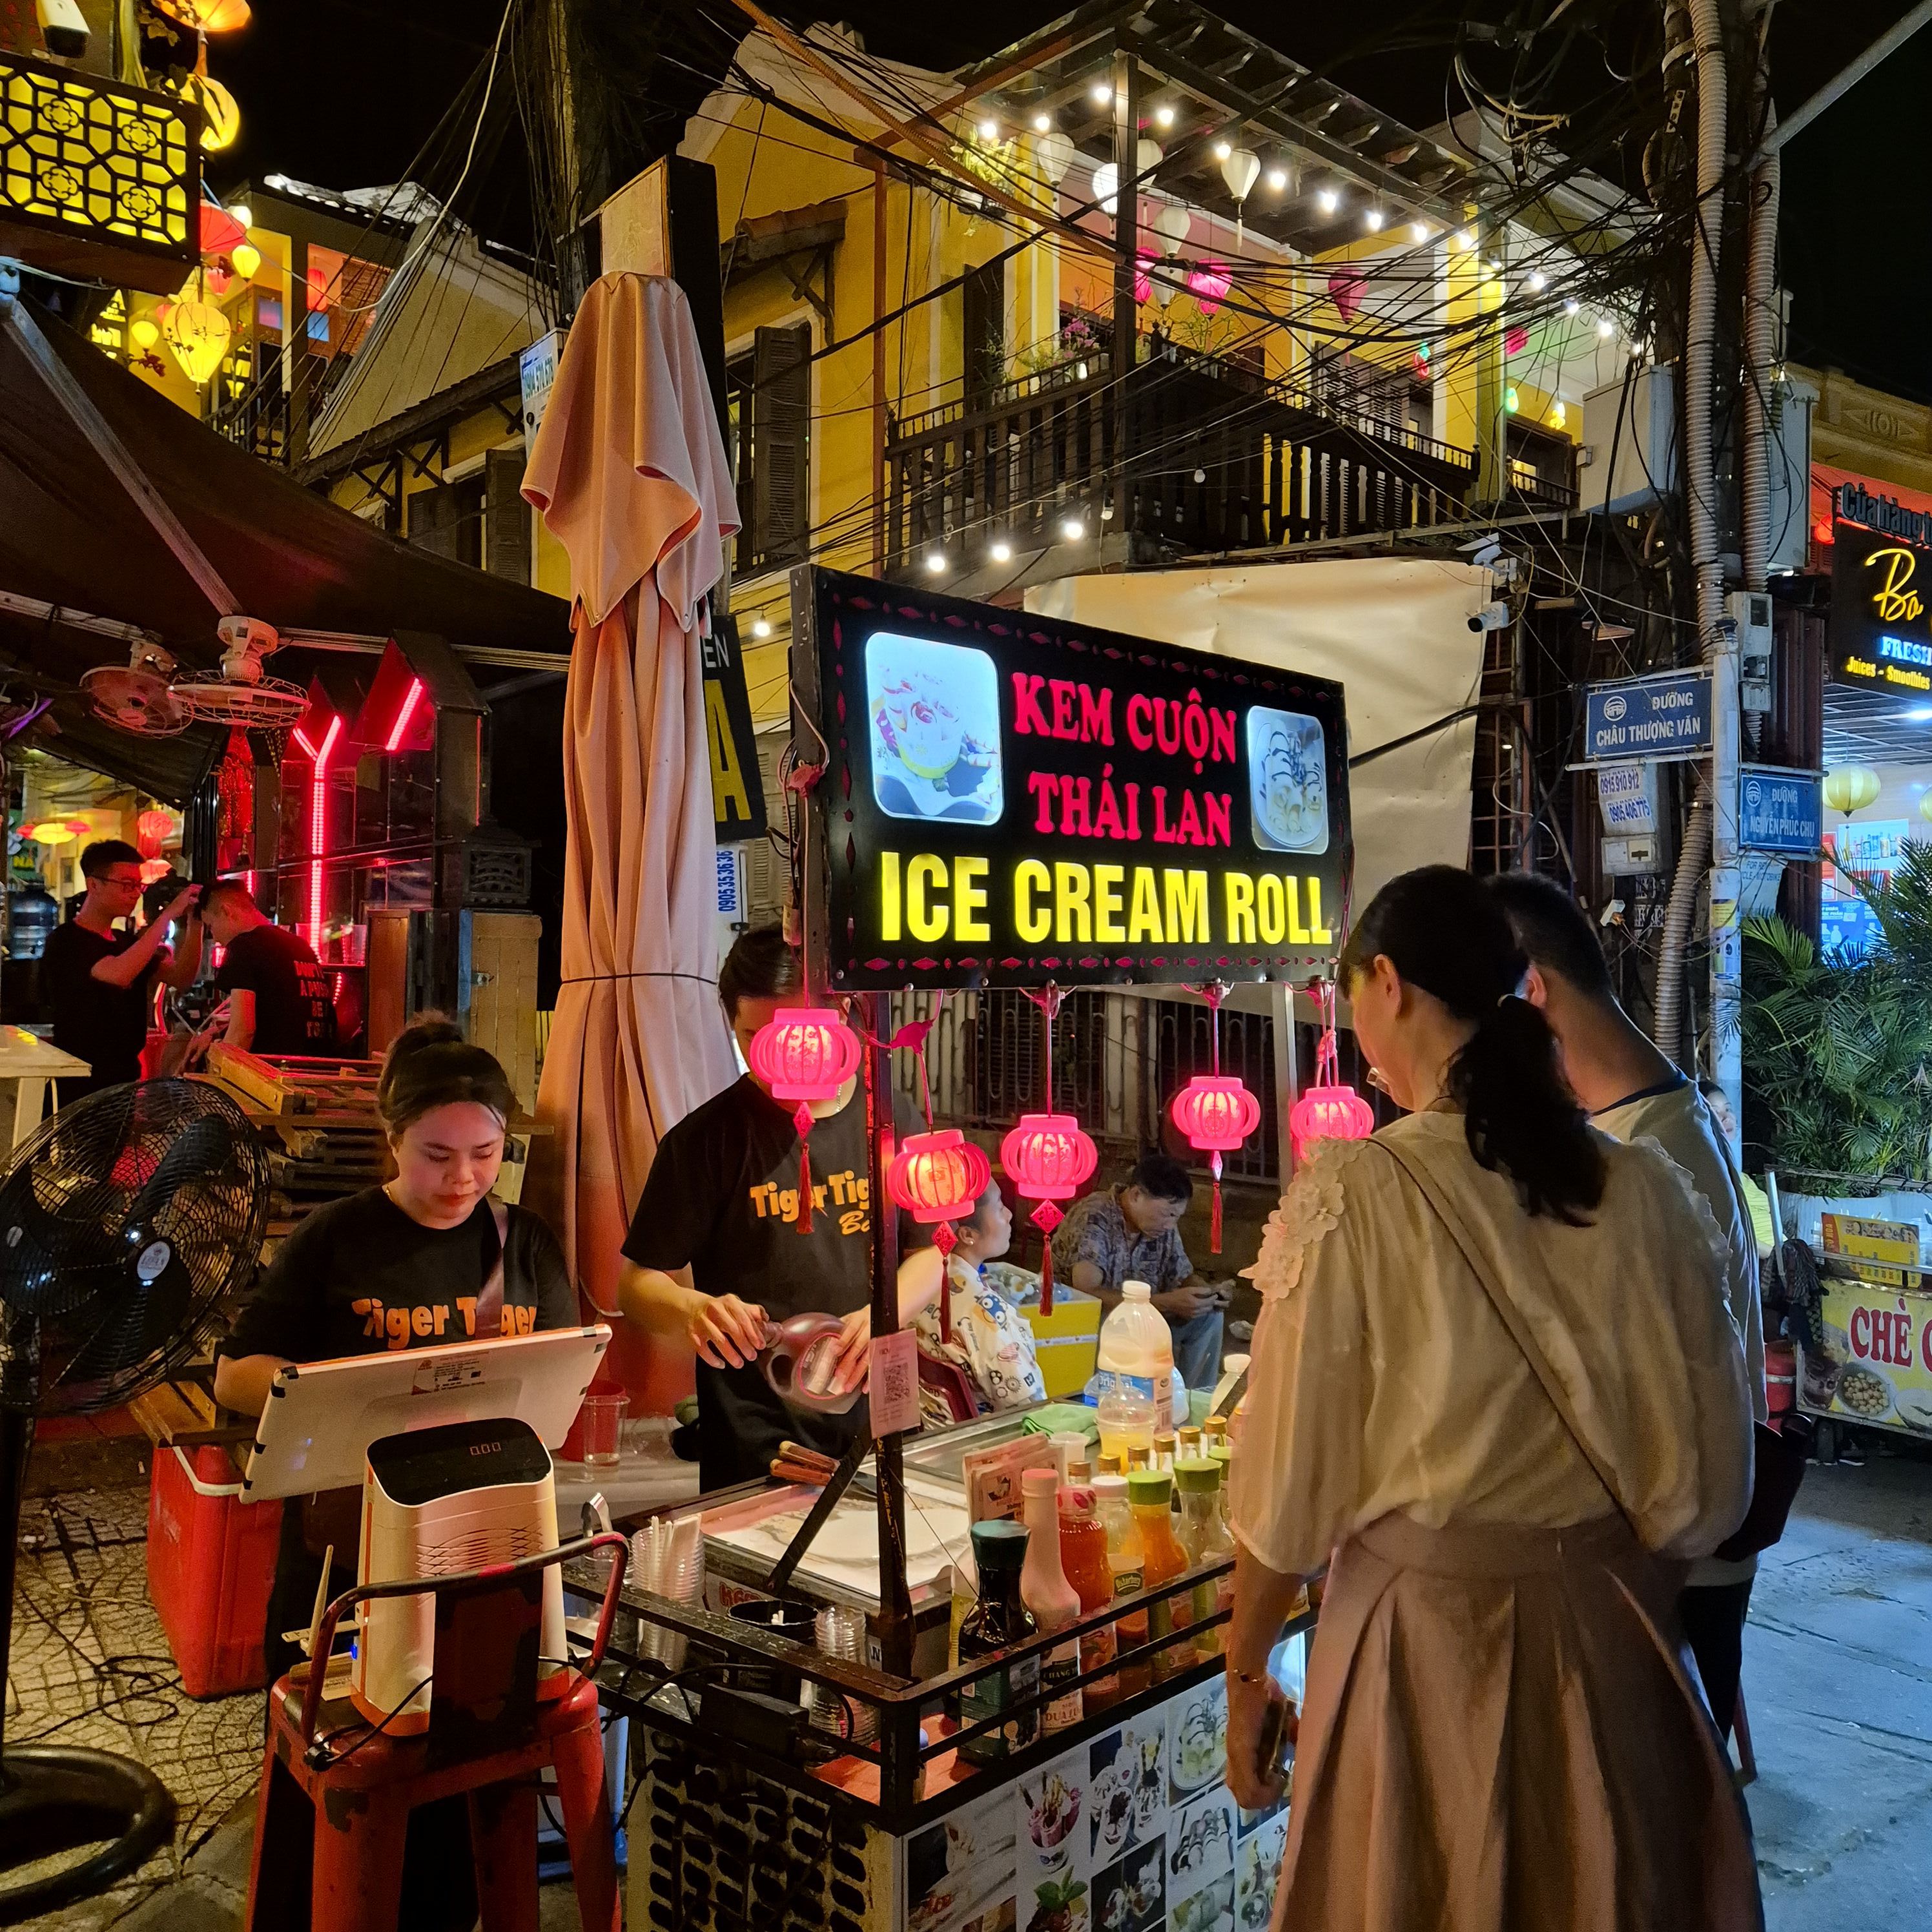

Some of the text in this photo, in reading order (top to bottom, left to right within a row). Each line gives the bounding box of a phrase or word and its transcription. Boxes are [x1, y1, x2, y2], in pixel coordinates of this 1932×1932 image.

[1878, 493, 1923, 543] hàng
[1846, 655, 1876, 678] Juices
[1886, 664, 1931, 690] Smoothies
[1011, 672, 1237, 775] KEM CUỘN
[1652, 692, 1694, 710] ĐƯỜNG
[1596, 715, 1701, 747] CHÂU THƯỢNG VĂN
[1028, 764, 1232, 847] THÁI LAN
[1778, 816, 1799, 837] PHÚC
[1800, 821, 1815, 838] CHU
[881, 852, 1332, 945] ICE CREAM ROLL
[750, 1181, 828, 1223] Tigr
[351, 1296, 537, 1350] Tiger Tger
[1851, 1298, 1913, 1368] CHÈ
